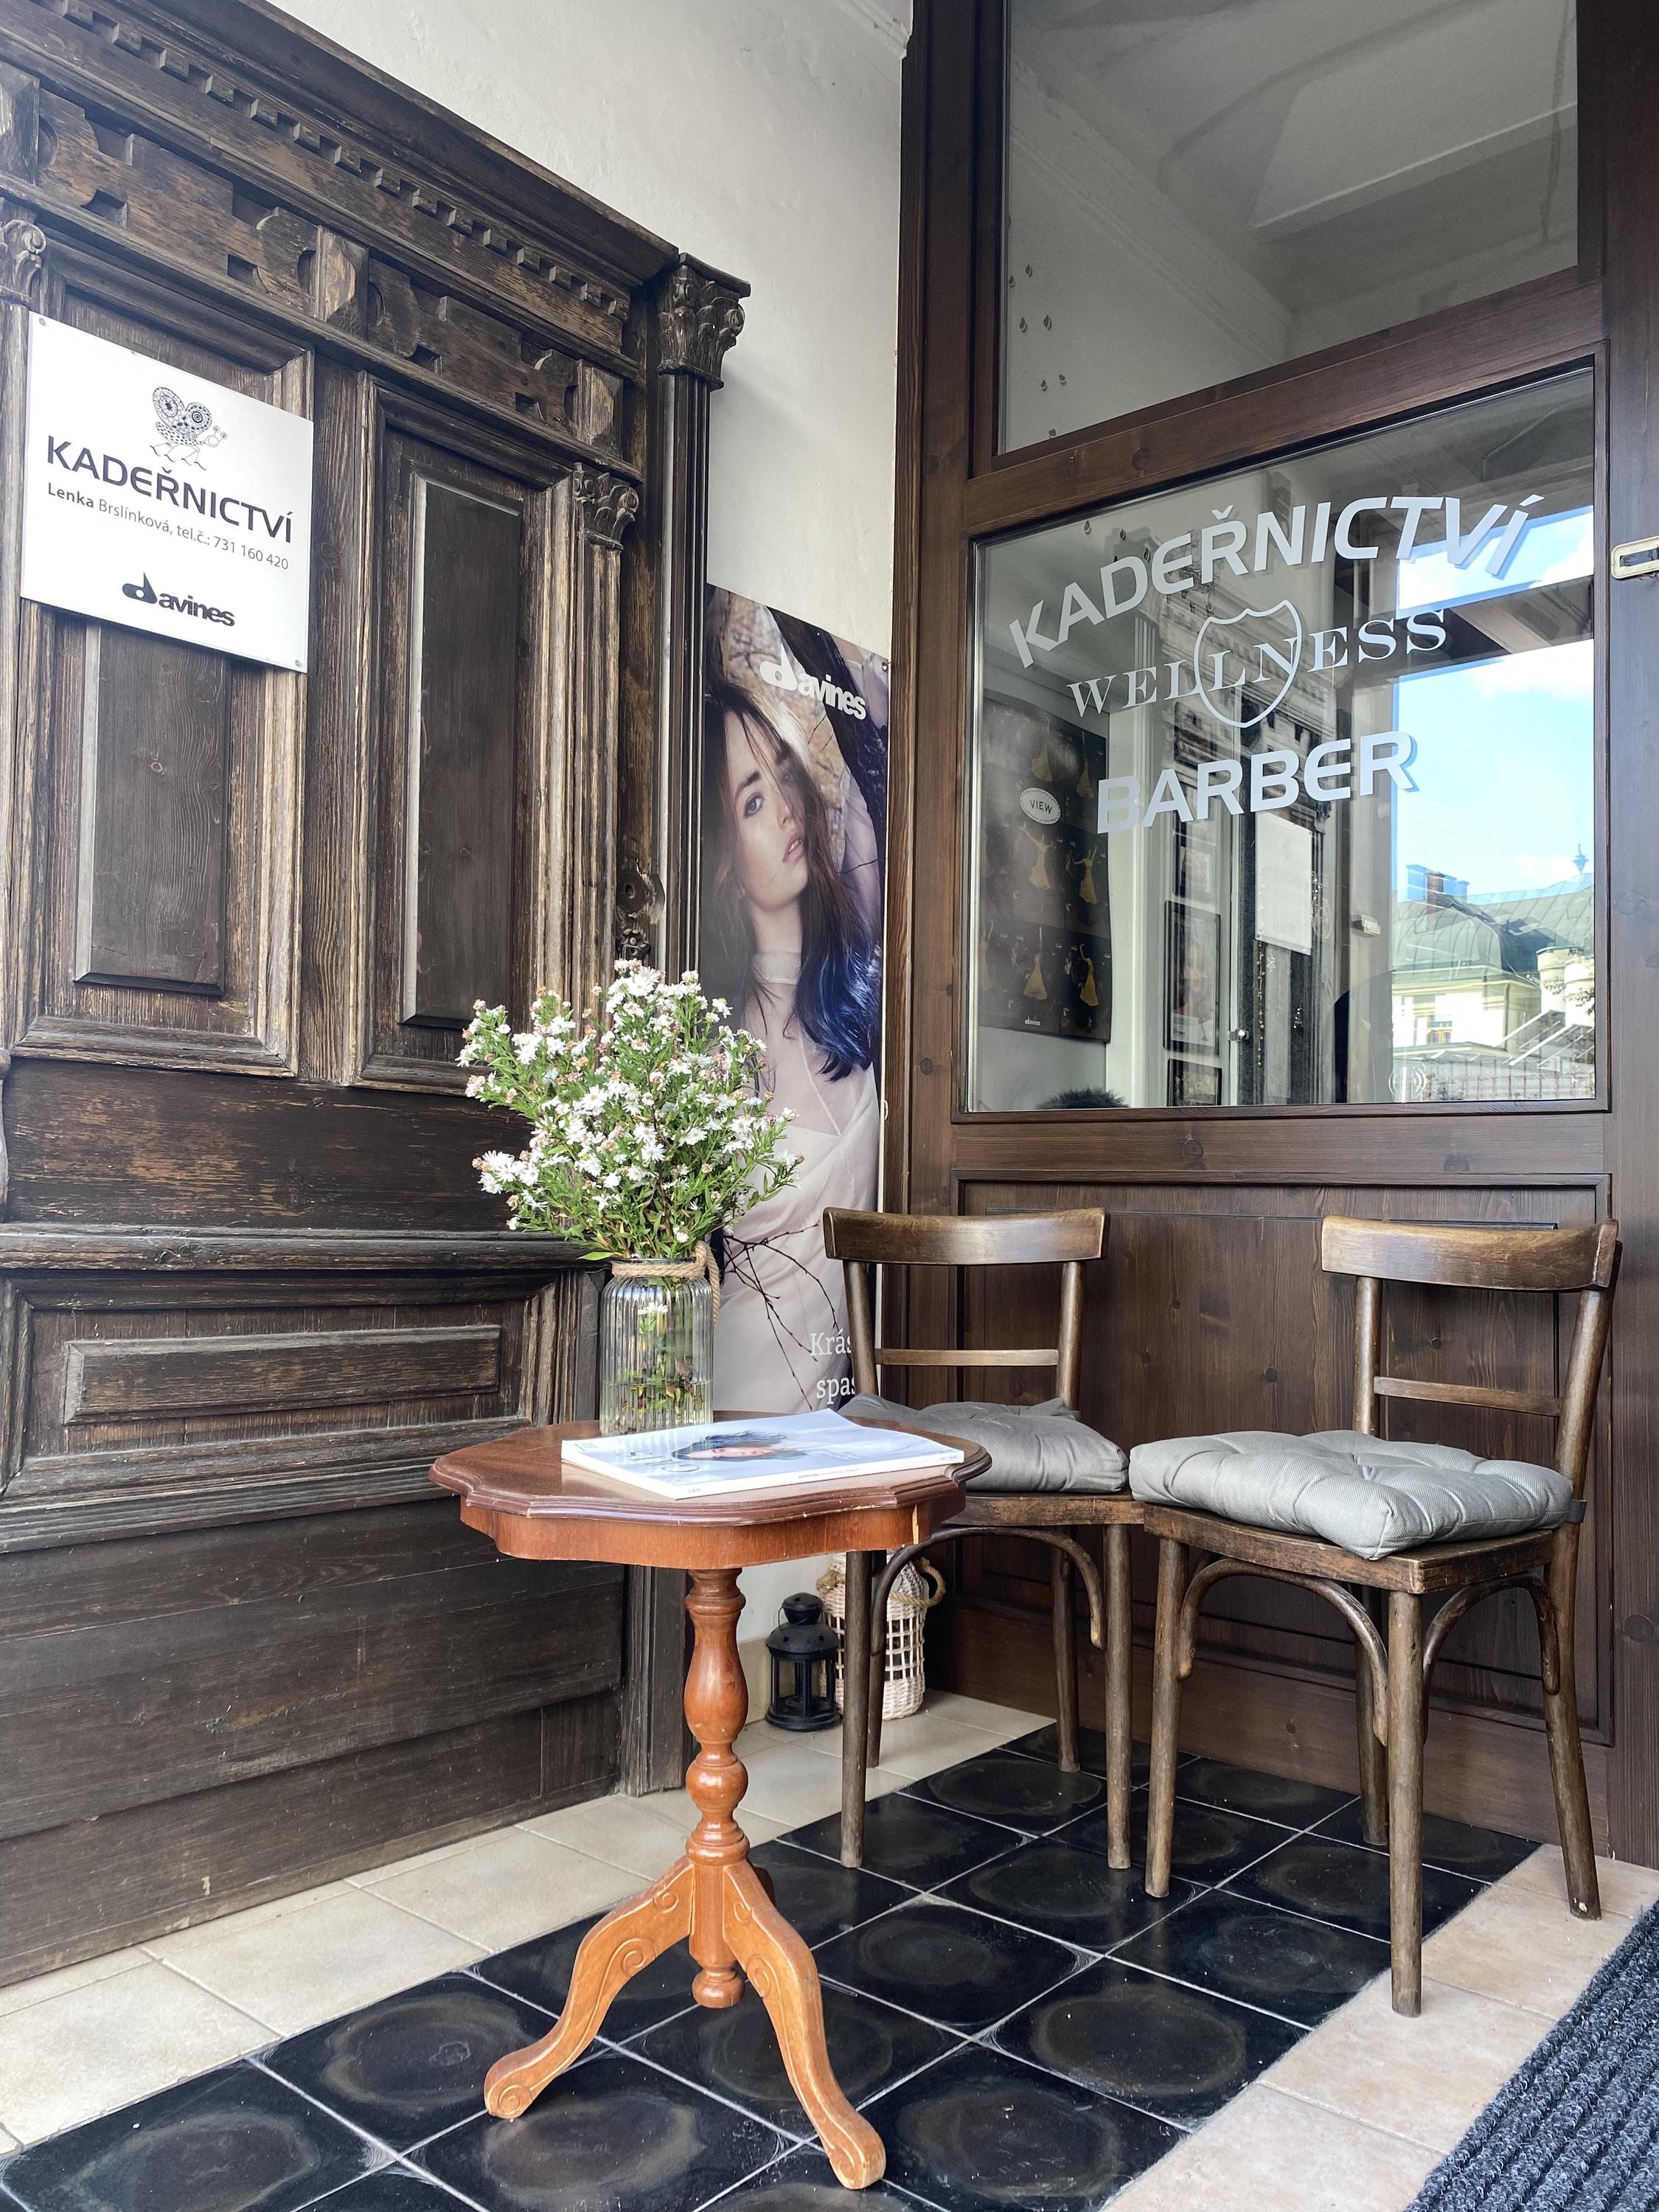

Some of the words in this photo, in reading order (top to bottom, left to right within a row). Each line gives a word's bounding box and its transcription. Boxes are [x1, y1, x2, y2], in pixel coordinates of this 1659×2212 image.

[47, 434, 293, 543] KADEŘNICTVÍ
[48, 482, 94, 508] Lenka
[99, 498, 173, 535] Brslínková,
[177, 524, 210, 546] tel.č.:
[213, 535, 235, 553] 731
[241, 545, 263, 562] 160
[266, 554, 288, 570] 420
[122, 571, 235, 627] davines
[1008, 493, 1545, 669] KADEŘNICTVÍ
[759, 643, 866, 720] davines
[1065, 609, 1448, 719] WELLNESS
[1029, 799, 1052, 815] VIEW
[1096, 731, 1416, 834] BARBER
